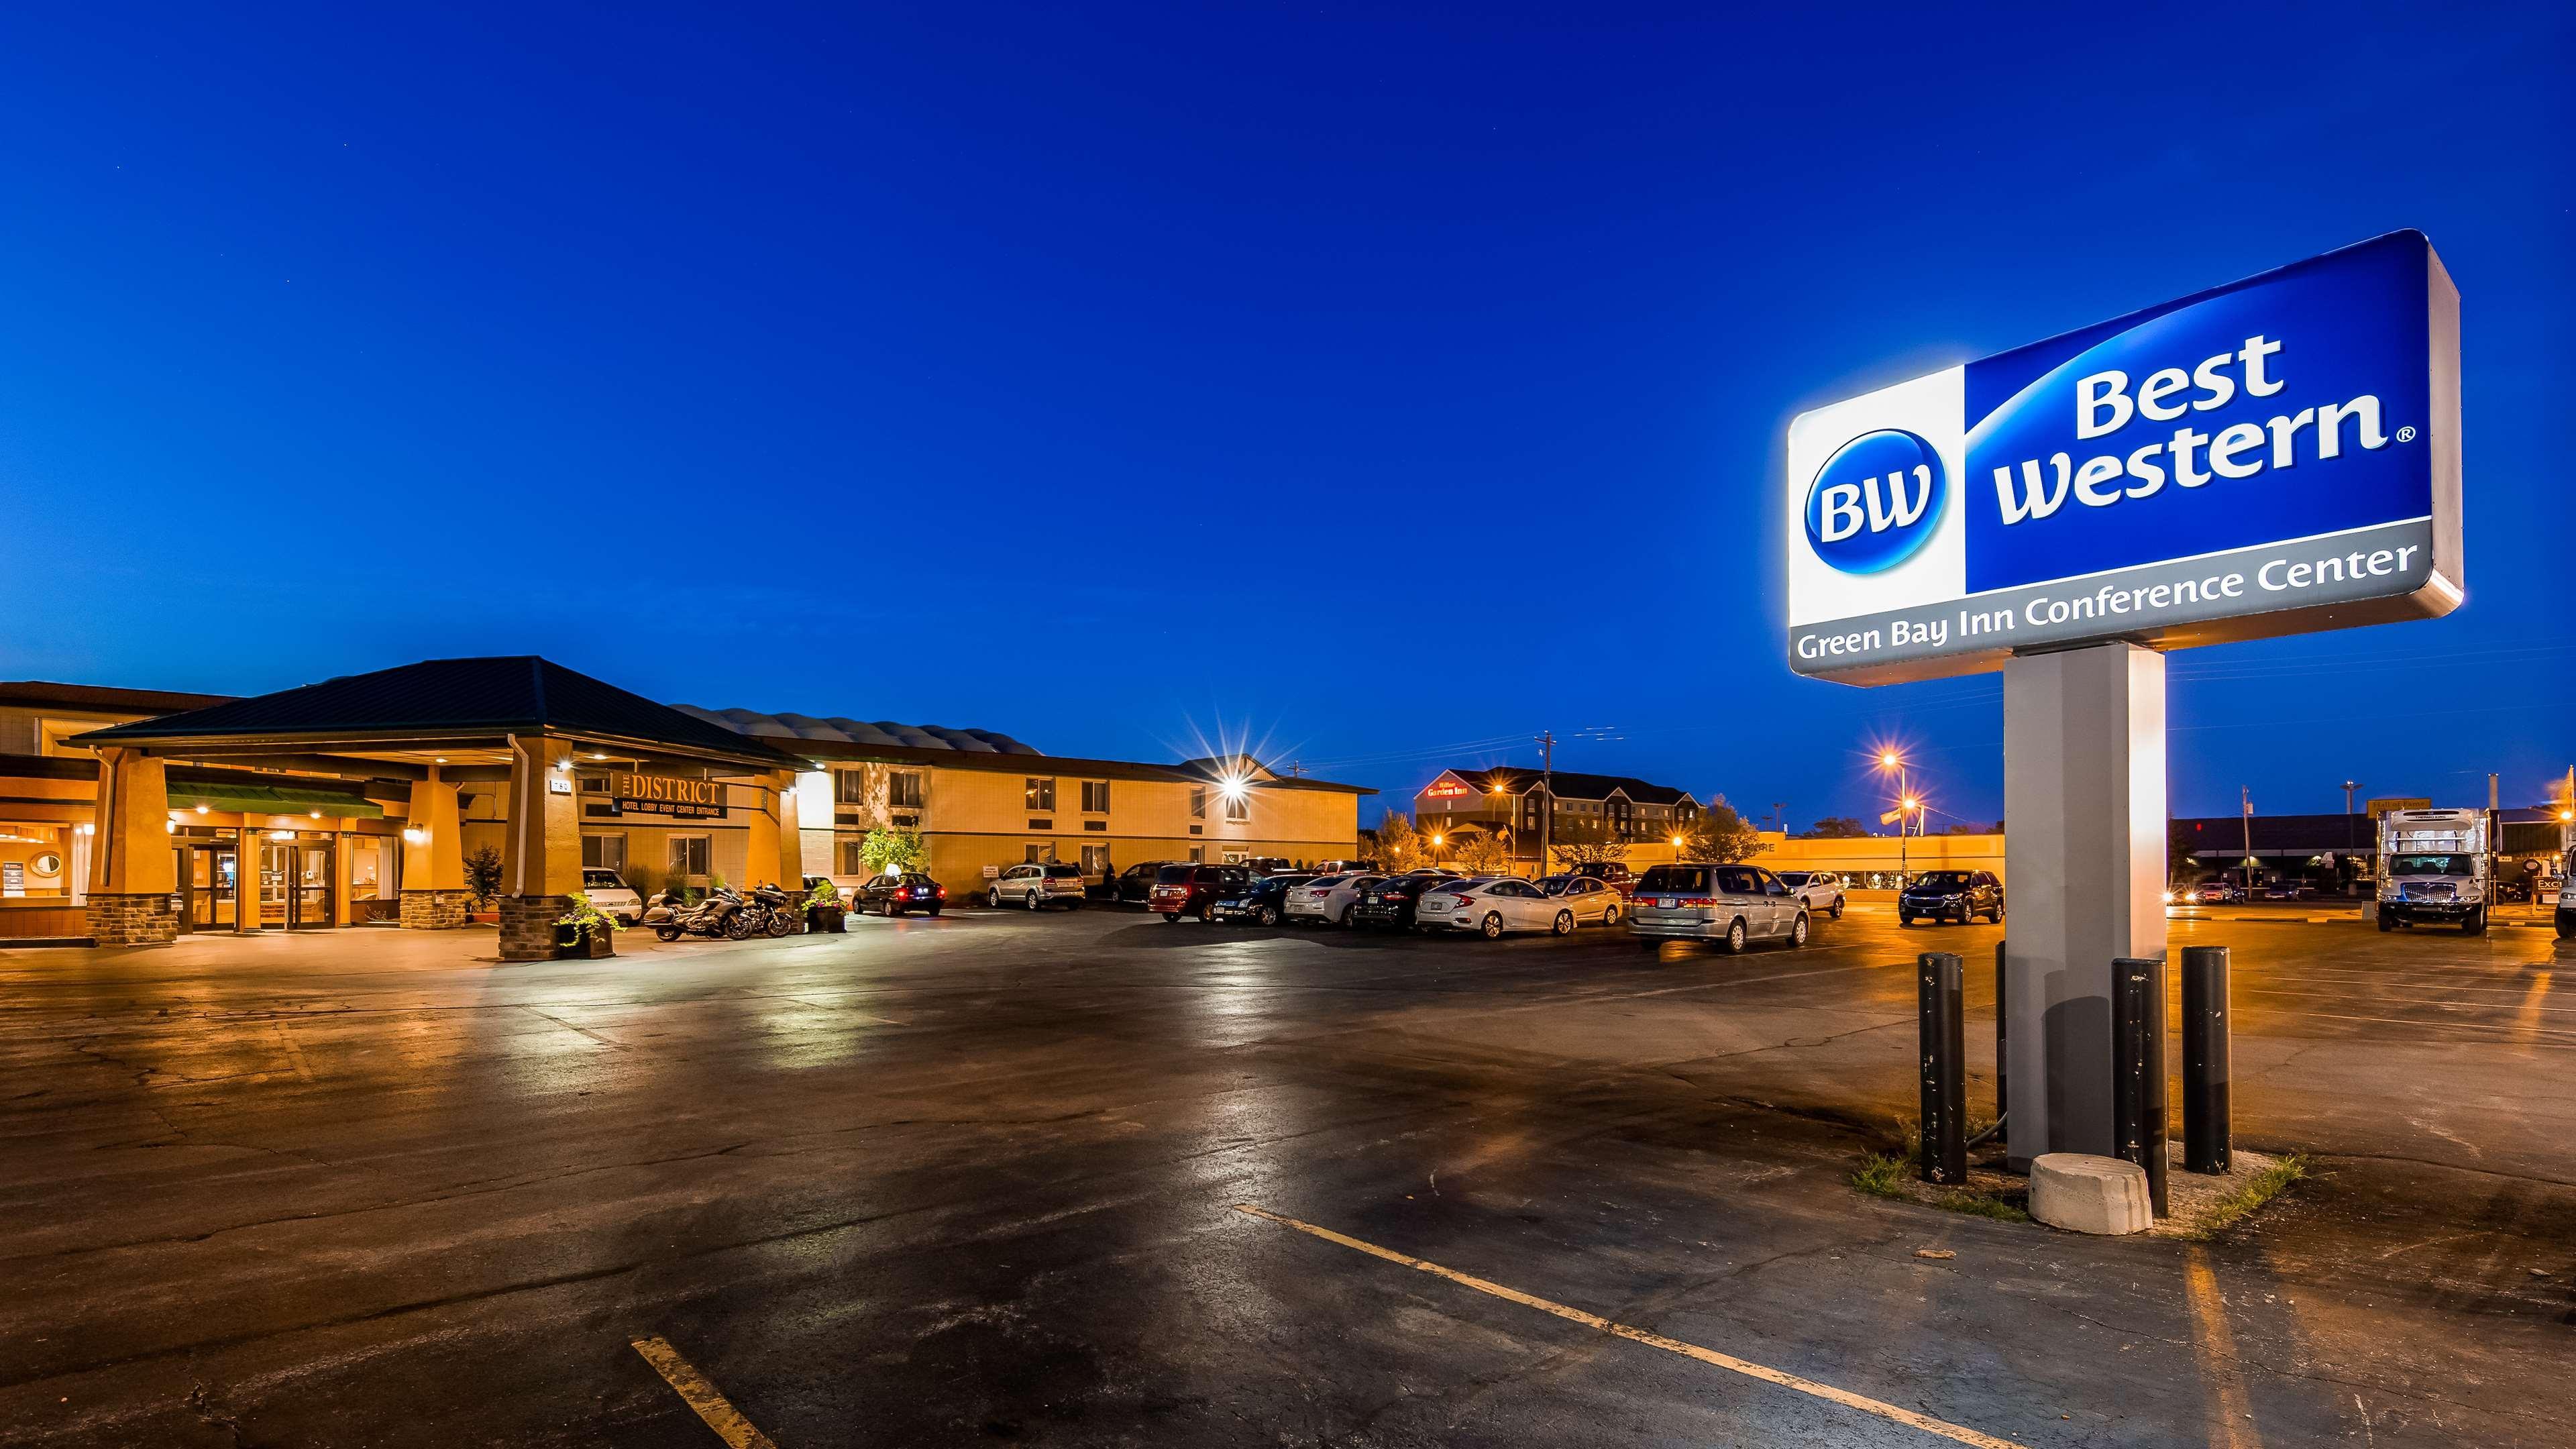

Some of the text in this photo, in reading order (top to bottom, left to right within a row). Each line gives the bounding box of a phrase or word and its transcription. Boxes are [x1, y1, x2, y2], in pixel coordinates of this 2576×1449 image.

[2076, 335, 2284, 440] Best
[1993, 394, 2389, 527] Western
[1821, 464, 1931, 543] BW
[1797, 545, 2418, 660] Green Bay Inn Conference Center
[623, 801, 719, 816] HOTEL LOBBY EVENT CENTER ENTRANCE
[632, 775, 720, 804] DISTRICT
[1428, 787, 1467, 796] Garden Inn
